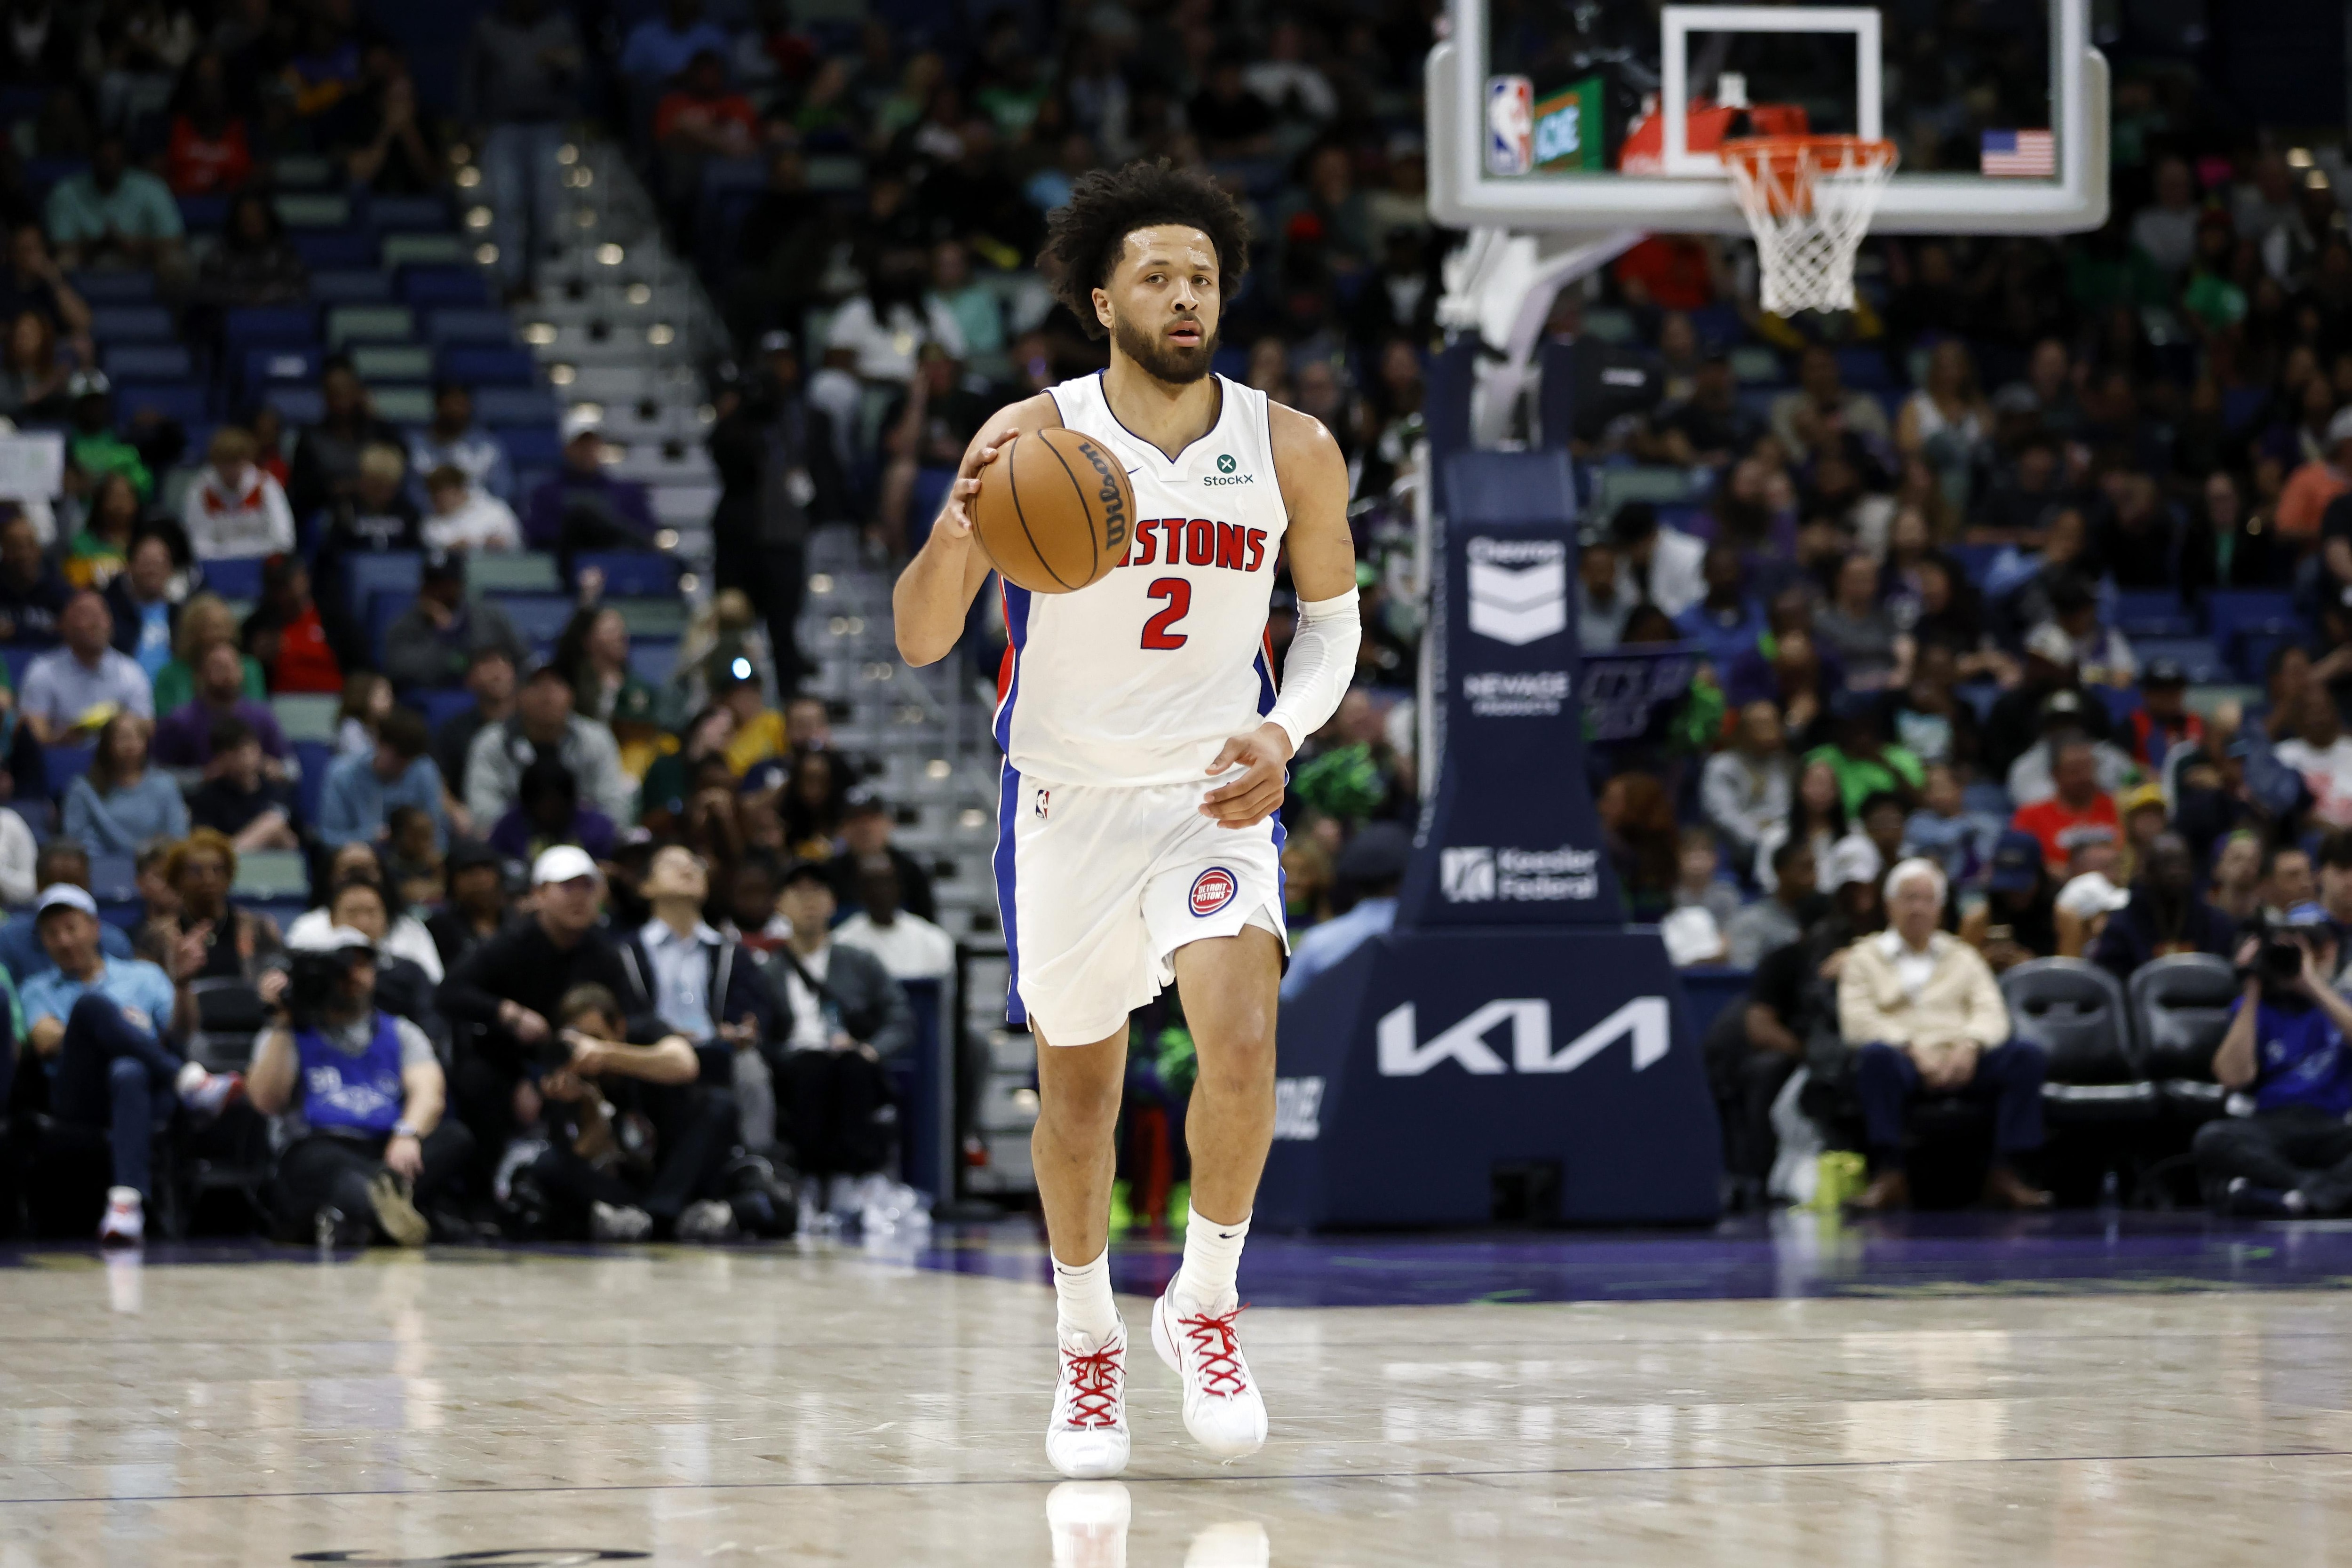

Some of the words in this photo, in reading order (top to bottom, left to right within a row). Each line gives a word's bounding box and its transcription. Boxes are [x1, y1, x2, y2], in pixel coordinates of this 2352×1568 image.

[1078, 442, 1126, 550] Wilson
[1204, 474, 1254, 486] StockX
[1116, 518, 1268, 572] STONS
[1140, 577, 1192, 650] 2
[1196, 891, 1225, 903] PISTONS
[1199, 883, 1227, 894] DETROIT
